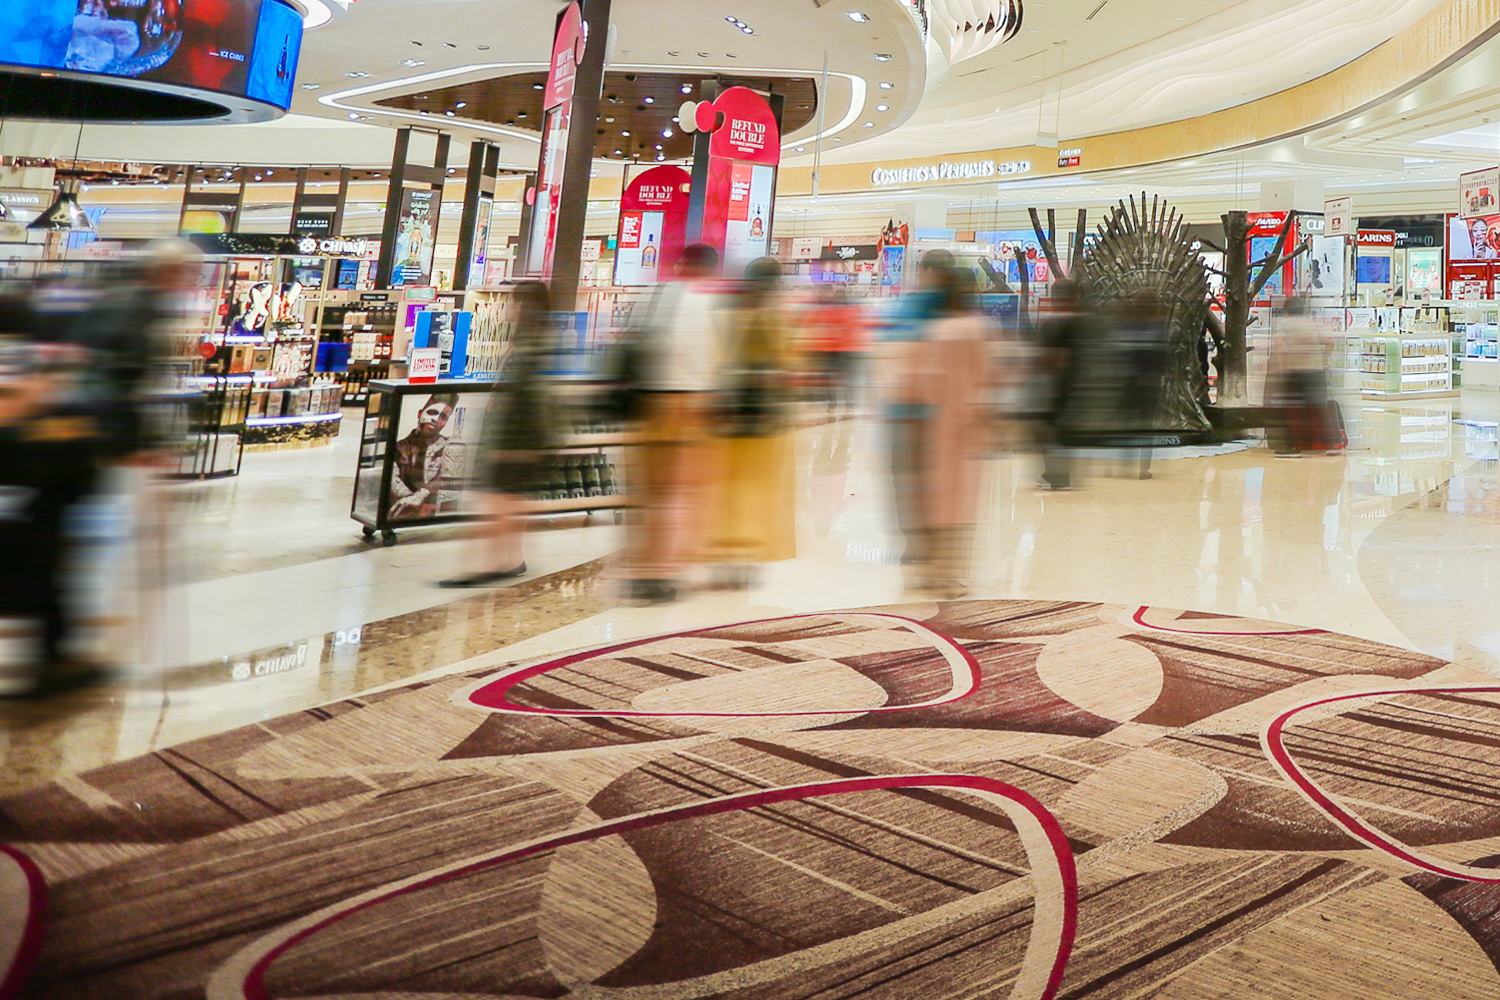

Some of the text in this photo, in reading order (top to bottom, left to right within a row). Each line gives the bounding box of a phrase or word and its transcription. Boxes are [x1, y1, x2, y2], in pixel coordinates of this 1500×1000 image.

[731, 119, 766, 134] REFUND
[730, 129, 765, 144] DOUBLE
[871, 166, 926, 185] COSMETICS
[928, 167, 938, 180] &
[938, 160, 995, 179] PERFUMES
[320, 240, 358, 253] CHIVAS
